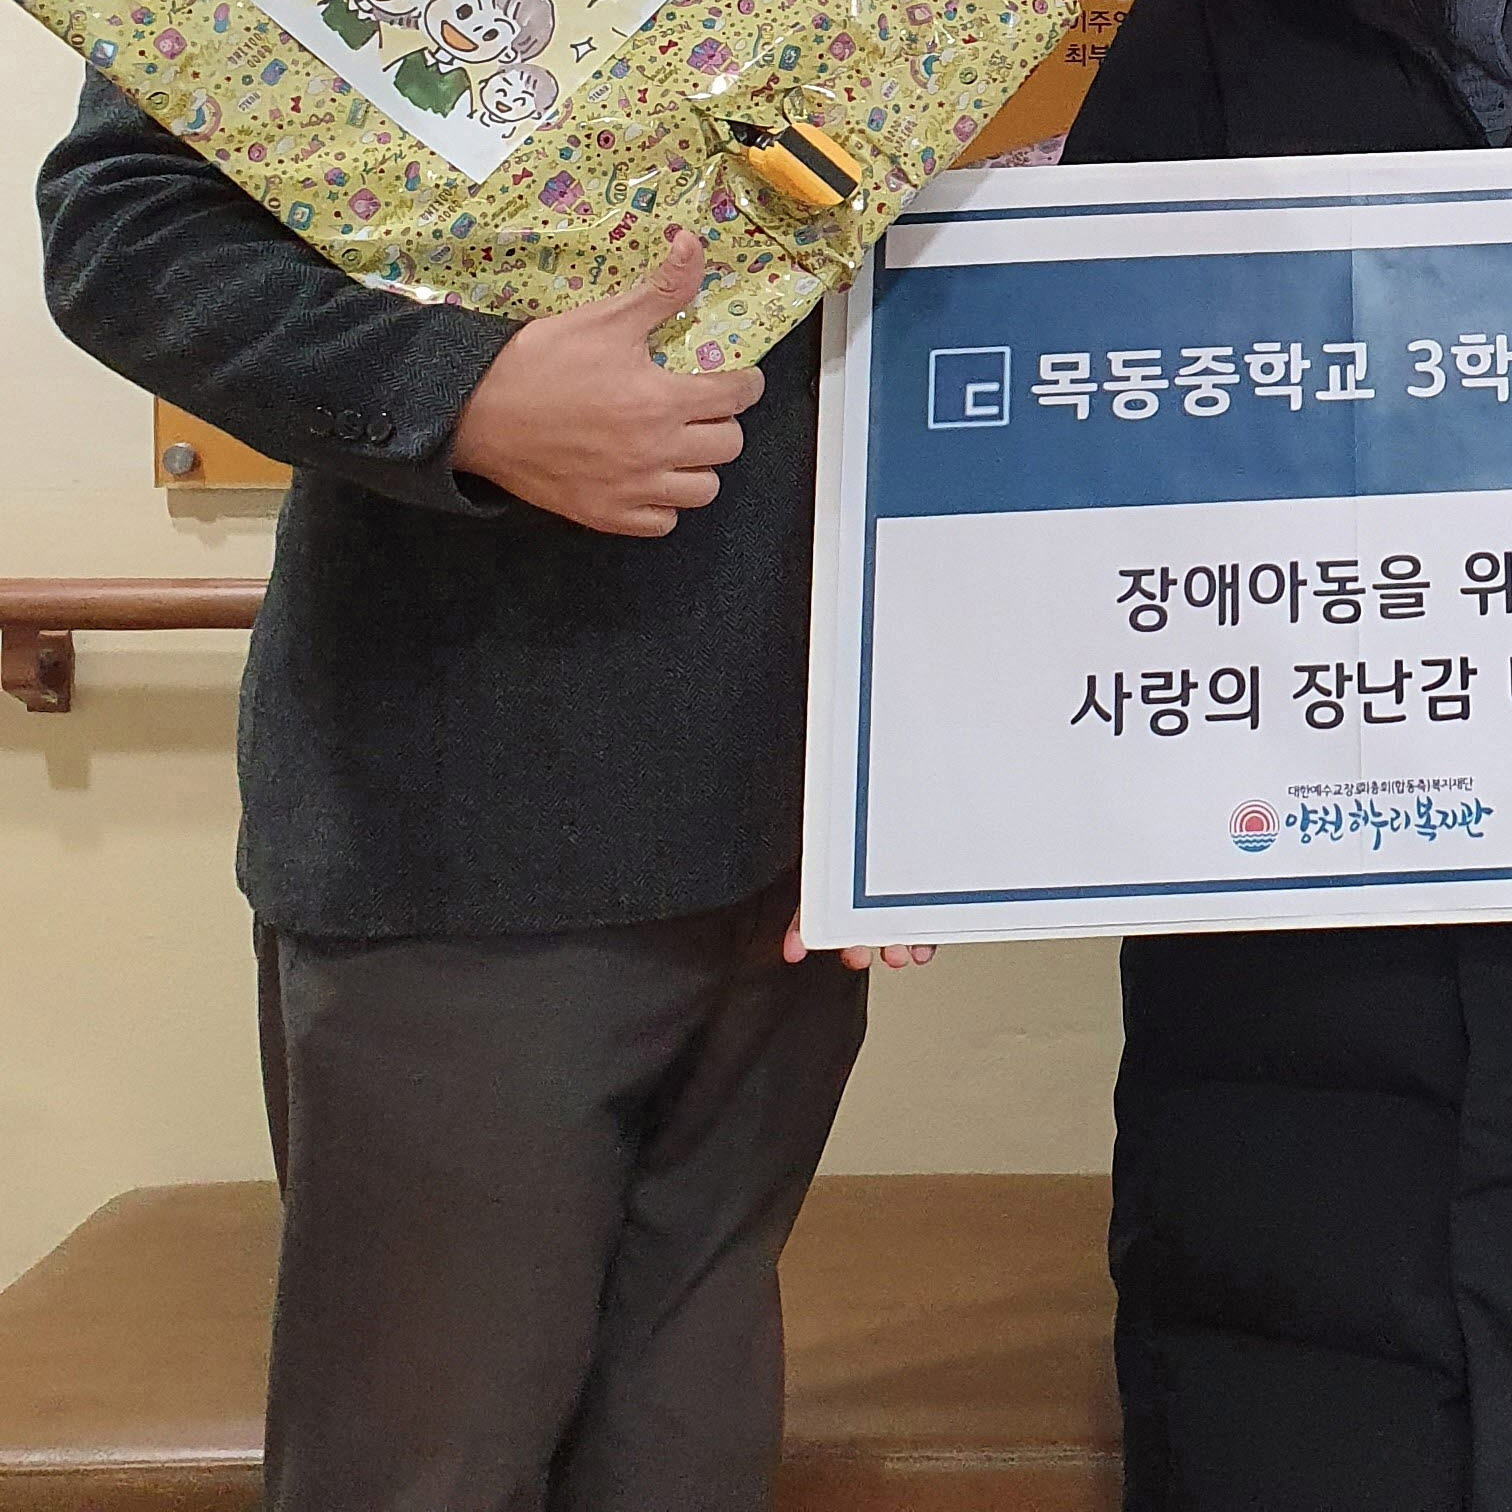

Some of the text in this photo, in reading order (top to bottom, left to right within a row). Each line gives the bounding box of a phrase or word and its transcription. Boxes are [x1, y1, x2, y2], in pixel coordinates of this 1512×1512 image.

[1032, 342, 1377, 422] 목동중학교
[1116, 553, 1431, 633] 장애아동을
[1071, 665, 1261, 737] 사랑의
[1292, 656, 1478, 731] 장난감
